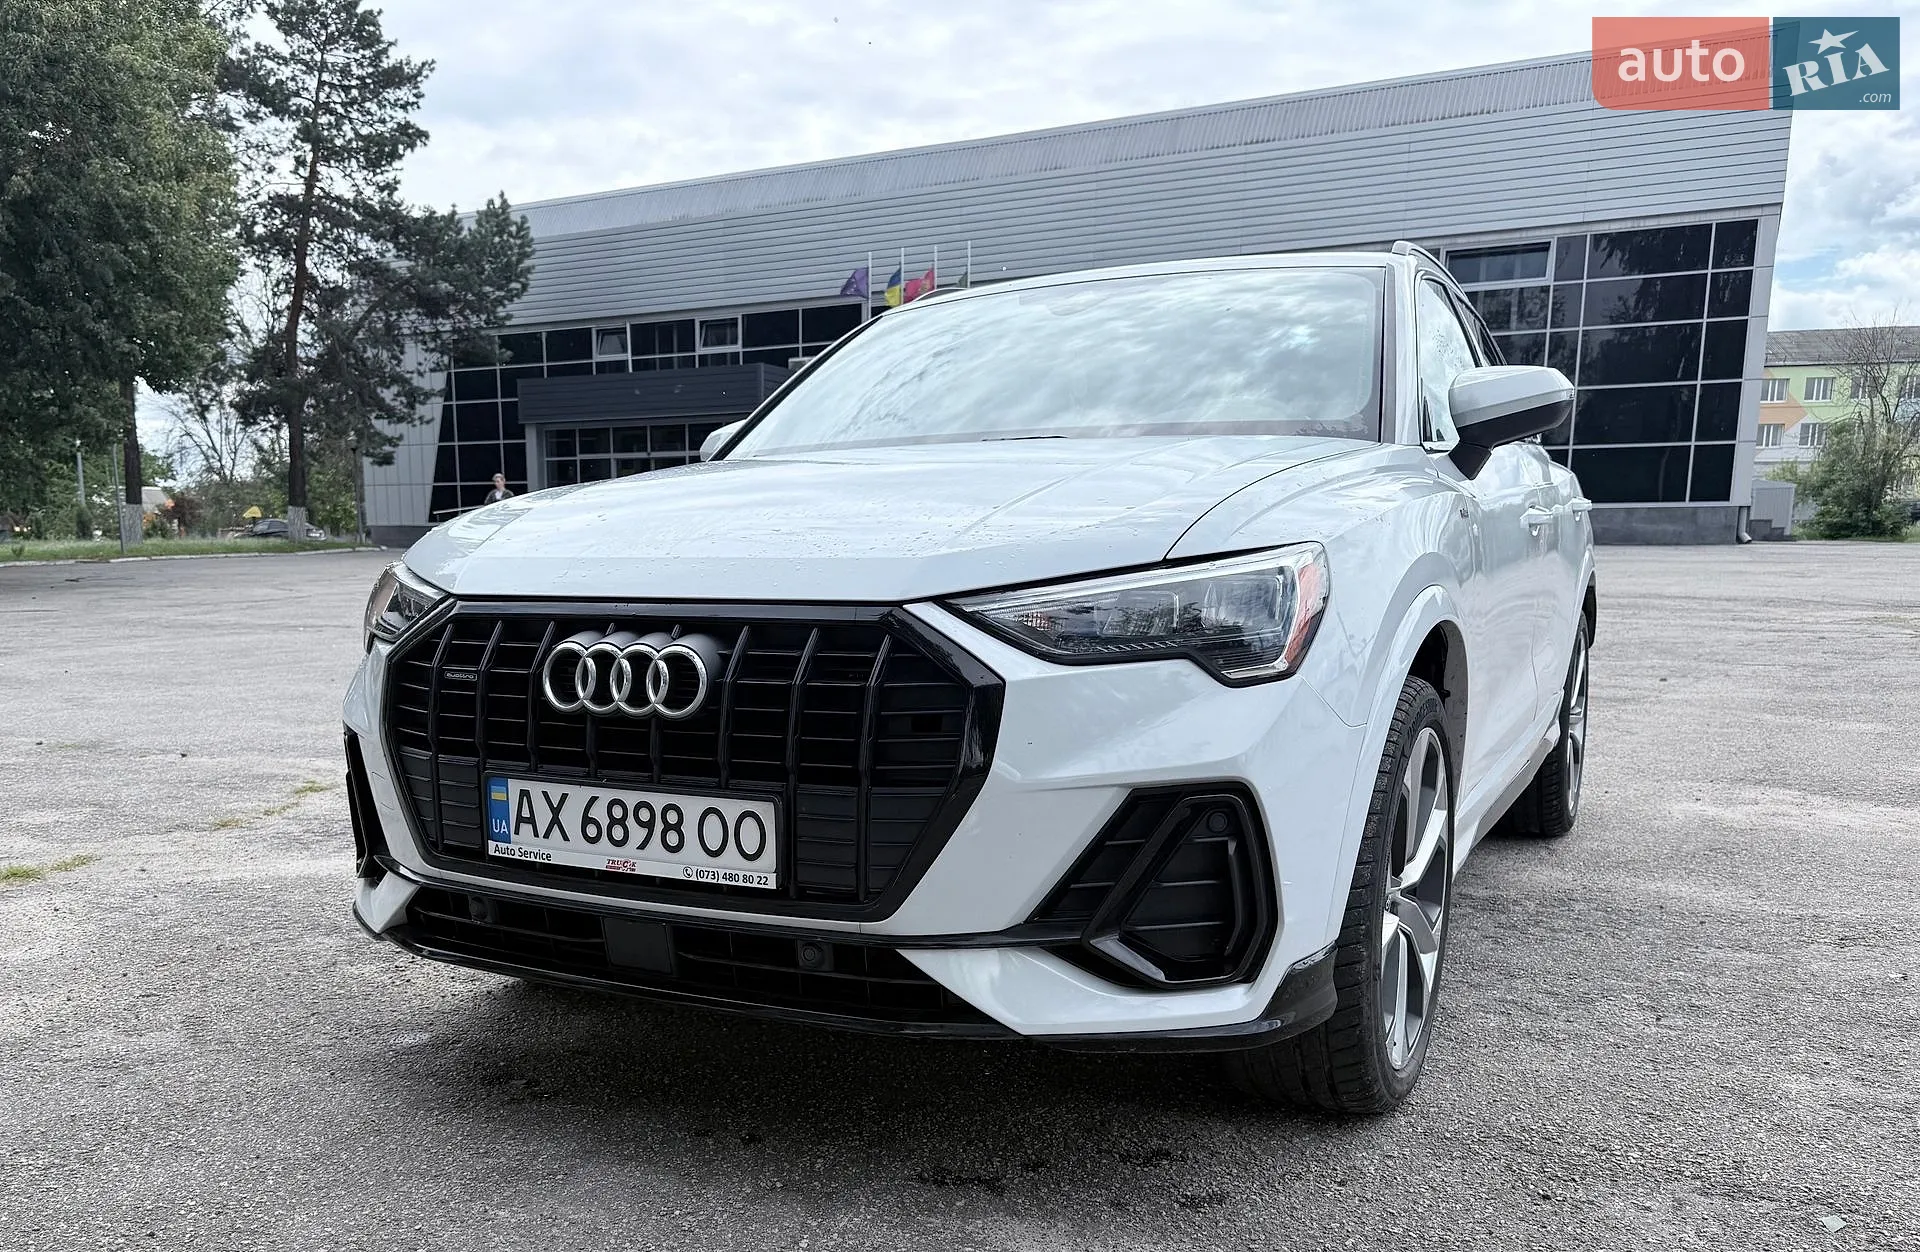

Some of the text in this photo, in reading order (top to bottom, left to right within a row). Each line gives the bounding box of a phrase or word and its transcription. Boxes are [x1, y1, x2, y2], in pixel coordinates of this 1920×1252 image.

[492, 818, 509, 835] UA
[513, 788, 571, 842] AX
[580, 795, 685, 854] 6898
[494, 844, 552, 861] Auto Service
[695, 868, 769, 886] (073) 480 80 22
